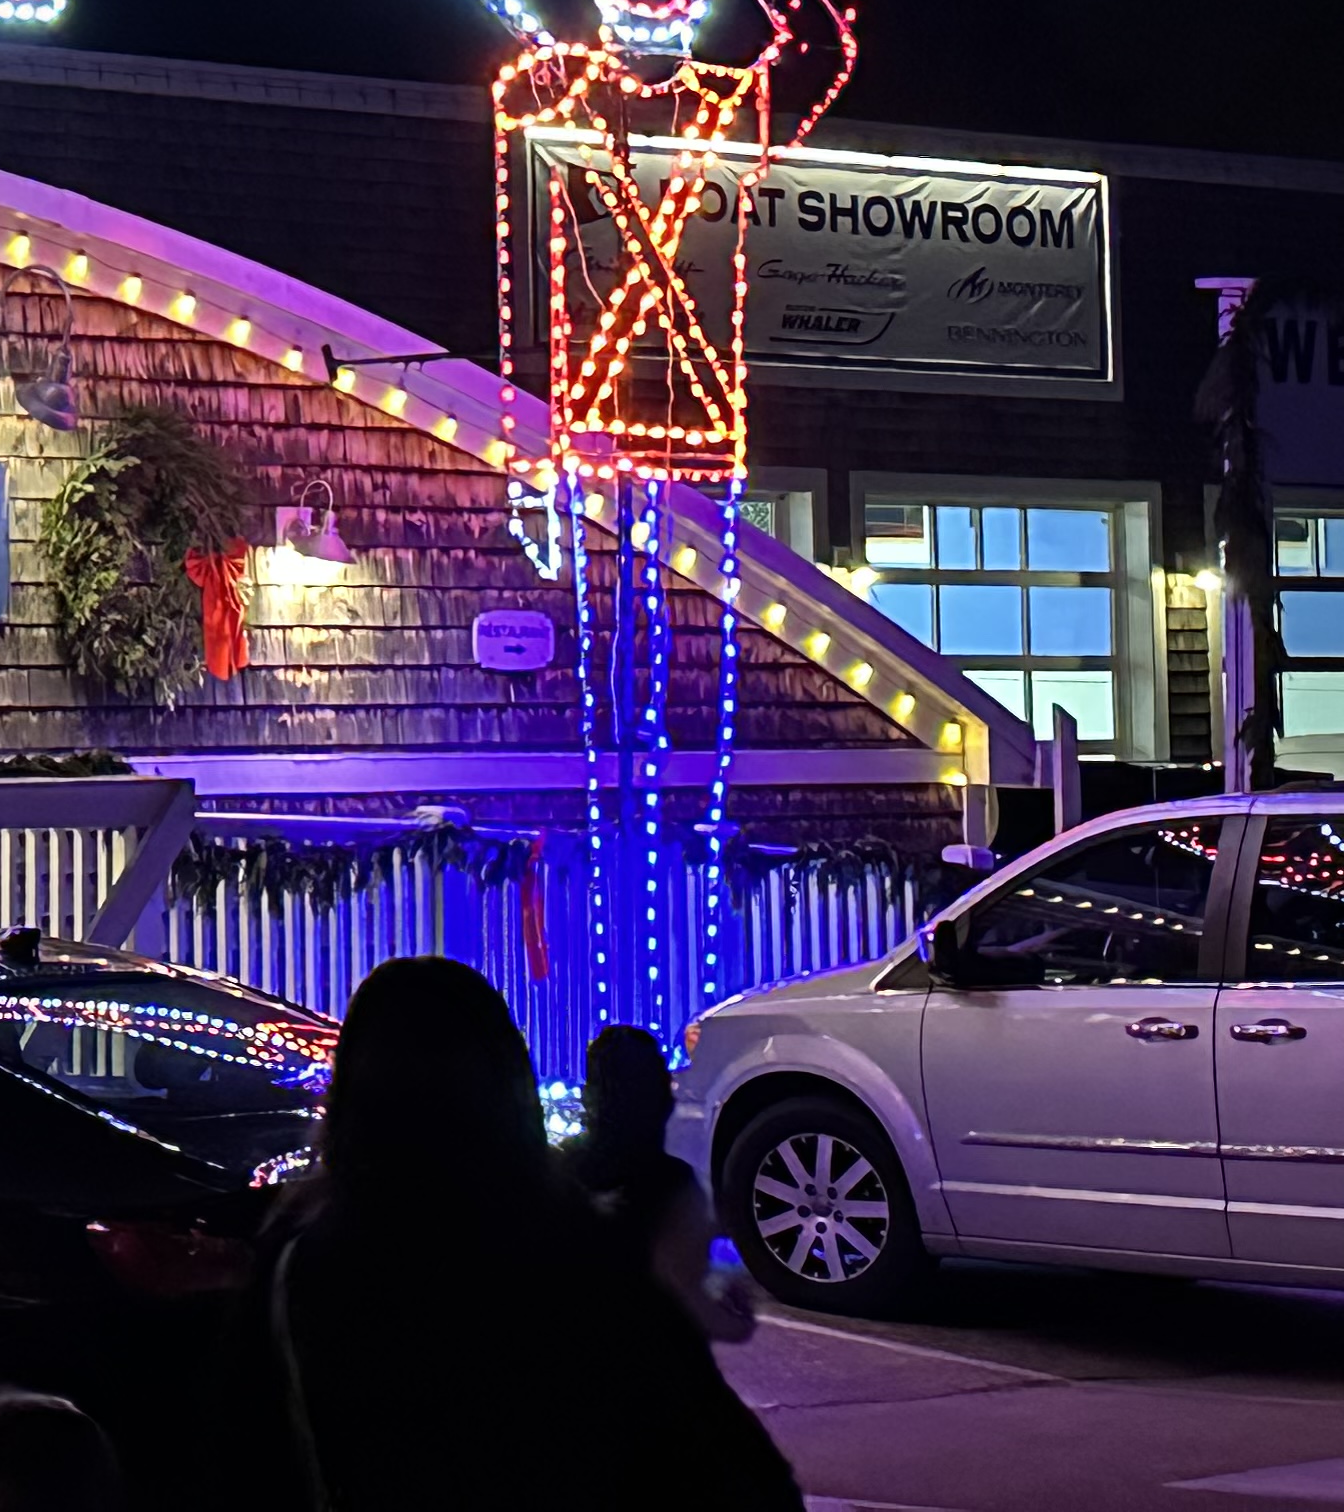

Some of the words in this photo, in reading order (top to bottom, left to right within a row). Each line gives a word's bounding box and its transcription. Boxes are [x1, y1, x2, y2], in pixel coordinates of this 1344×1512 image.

[659, 178, 786, 231] OAT
[798, 190, 1075, 249] SHOWROOM
[781, 314, 864, 333] WHALER
[947, 325, 1088, 348] BENNINGTON
